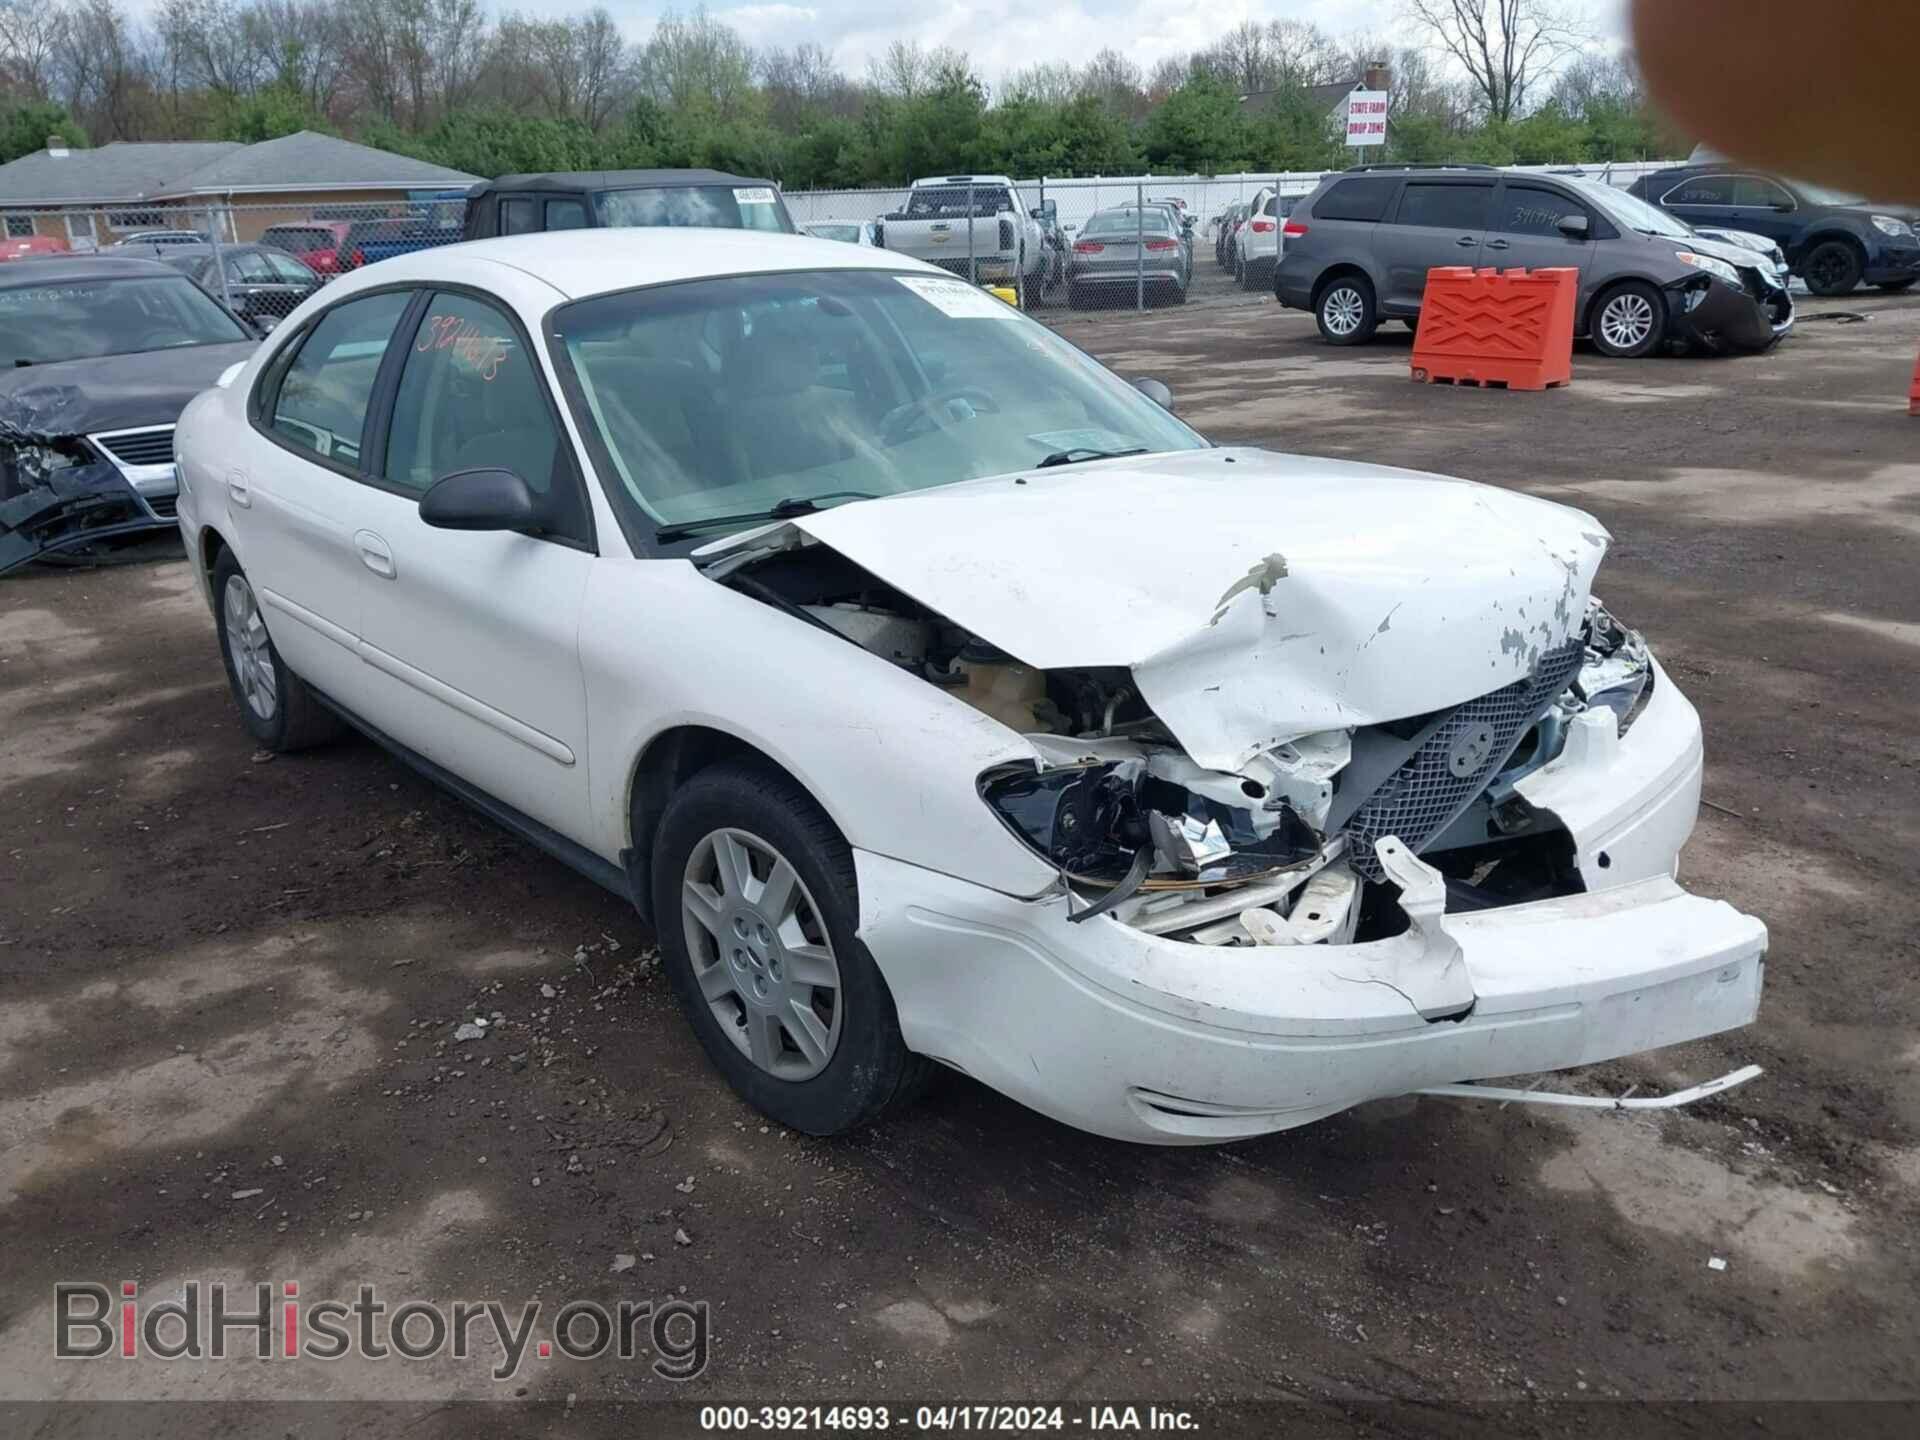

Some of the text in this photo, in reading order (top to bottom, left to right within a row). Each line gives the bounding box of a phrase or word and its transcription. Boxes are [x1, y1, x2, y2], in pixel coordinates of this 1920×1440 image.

[1350, 102, 1368, 114] STATE
[1349, 121, 1384, 134] DROP ZONE
